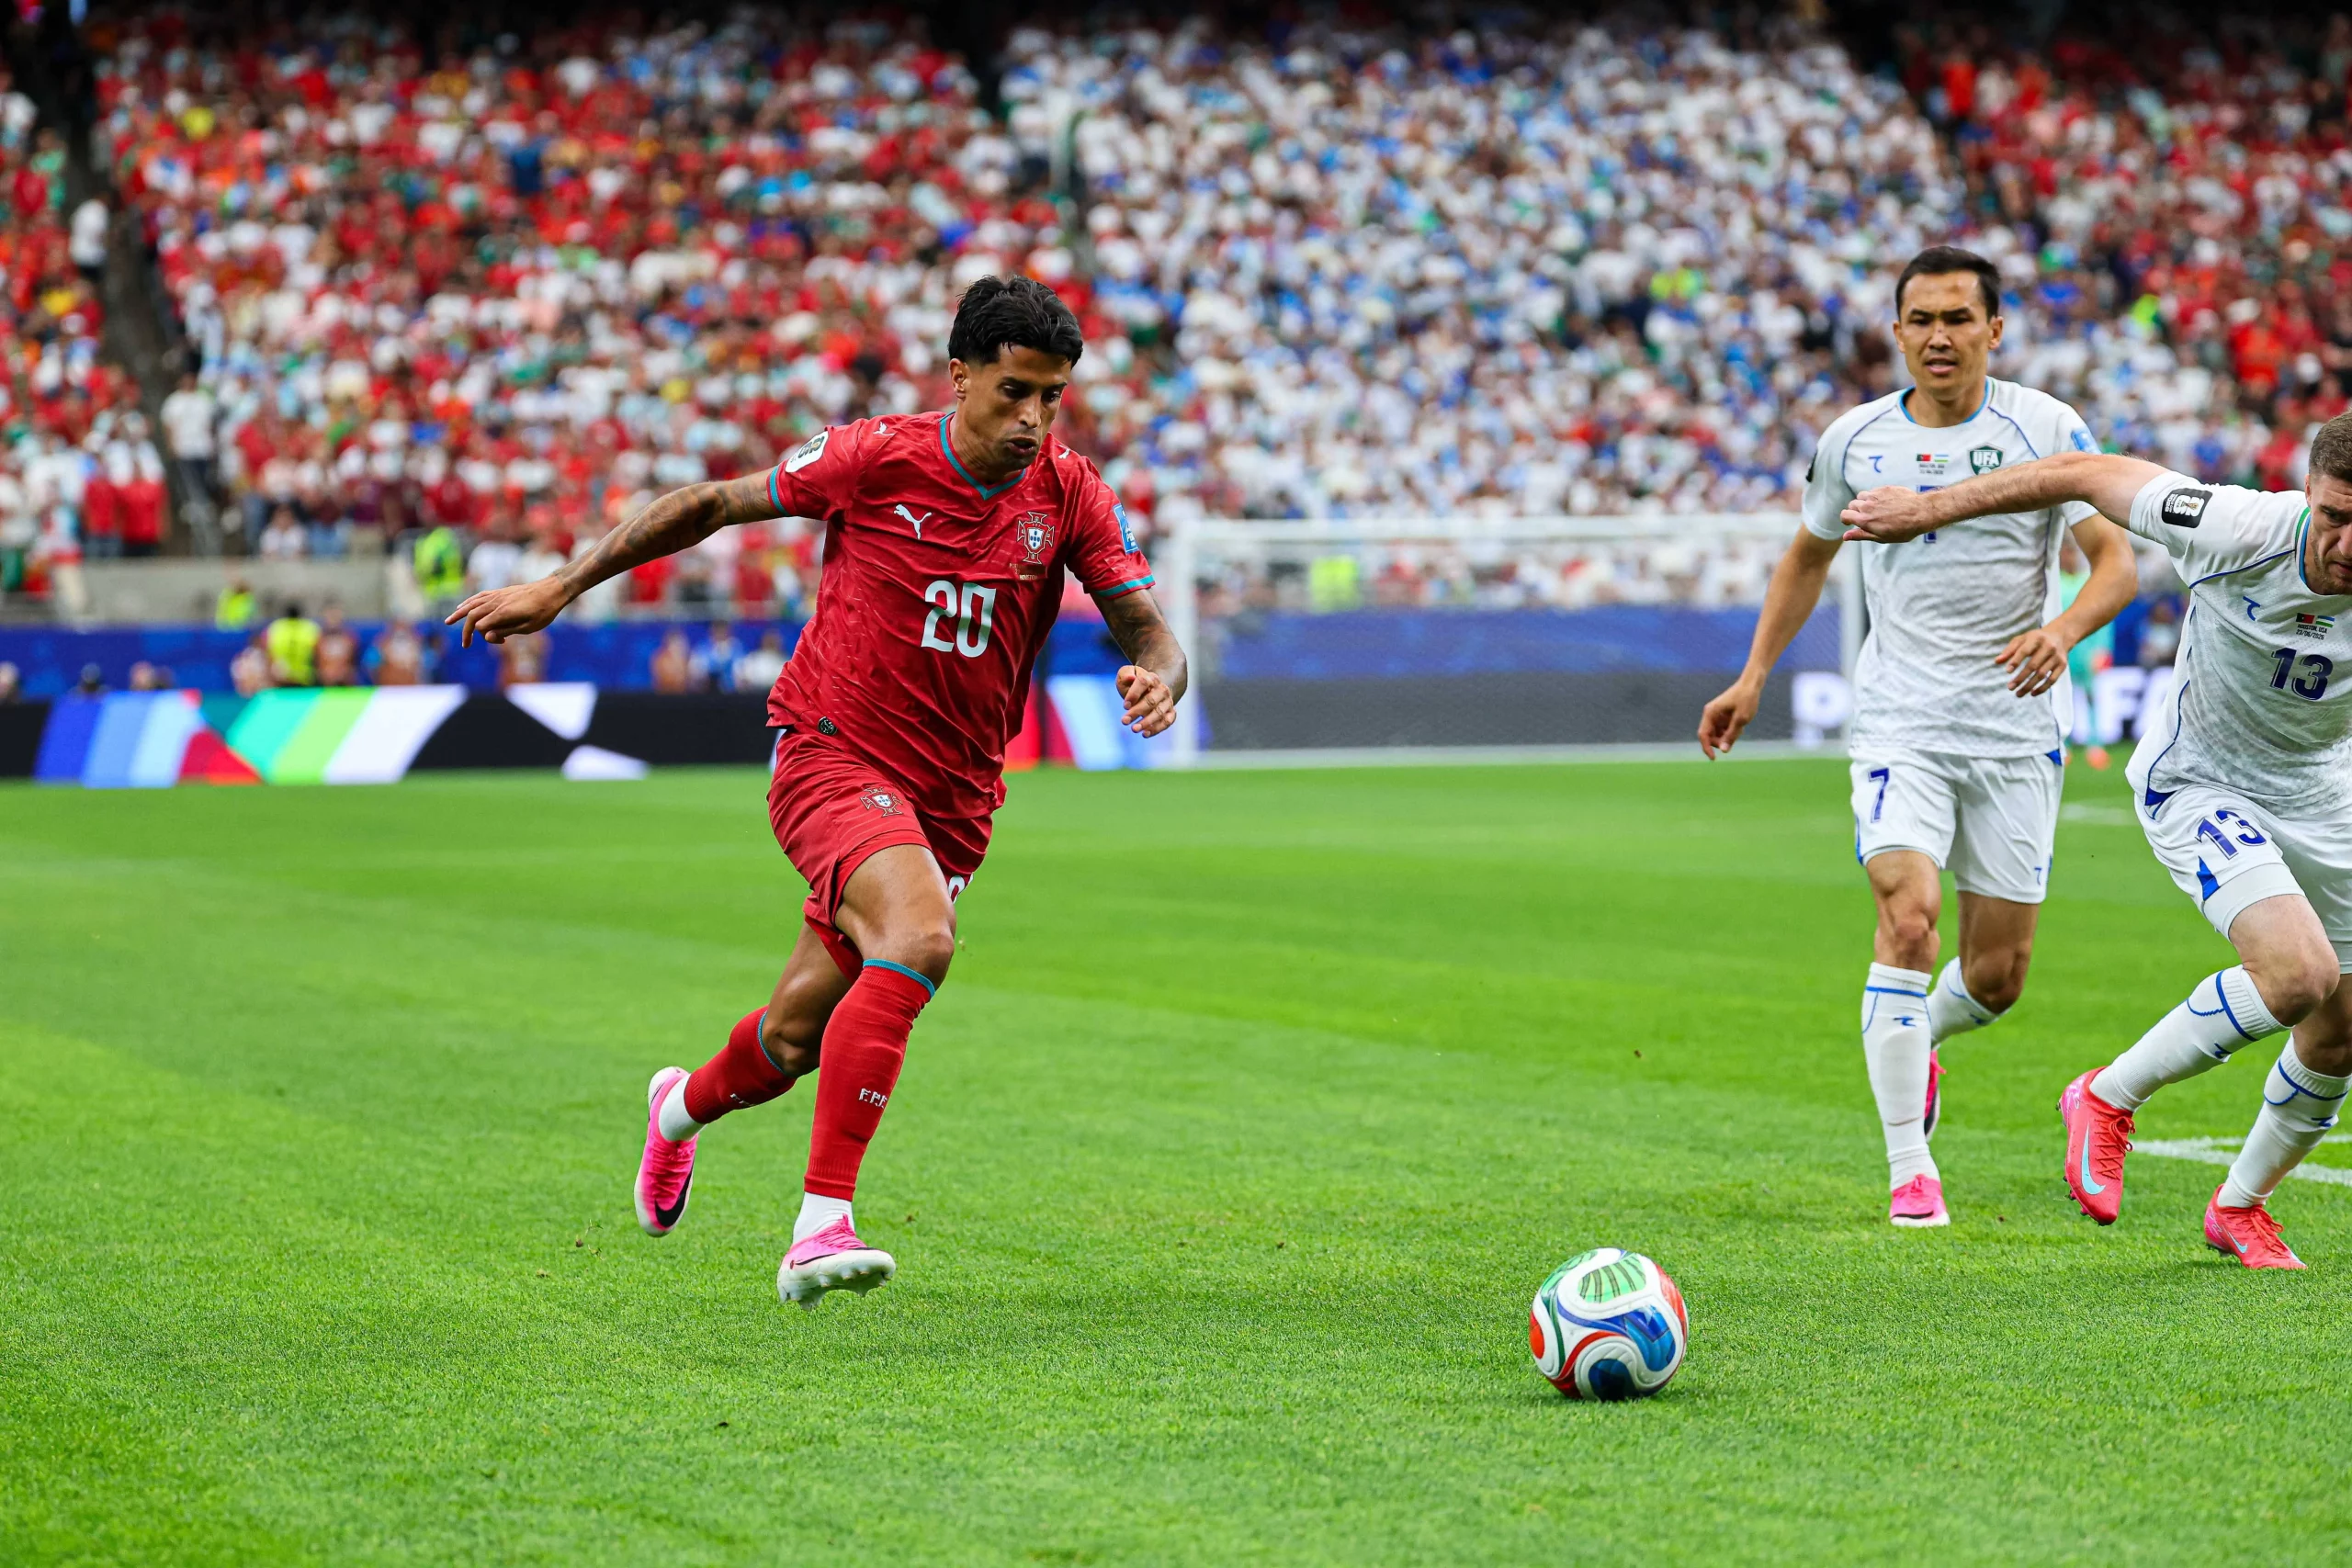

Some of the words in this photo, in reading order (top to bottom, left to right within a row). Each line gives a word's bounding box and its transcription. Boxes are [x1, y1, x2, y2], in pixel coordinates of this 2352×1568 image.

[1973, 451, 2000, 466] UFA
[921, 580, 997, 658] 20
[2296, 629, 2325, 640] 23/06/2026
[2269, 647, 2334, 702] 13
[1868, 767, 1890, 823] 7
[2195, 809, 2267, 861] 13
